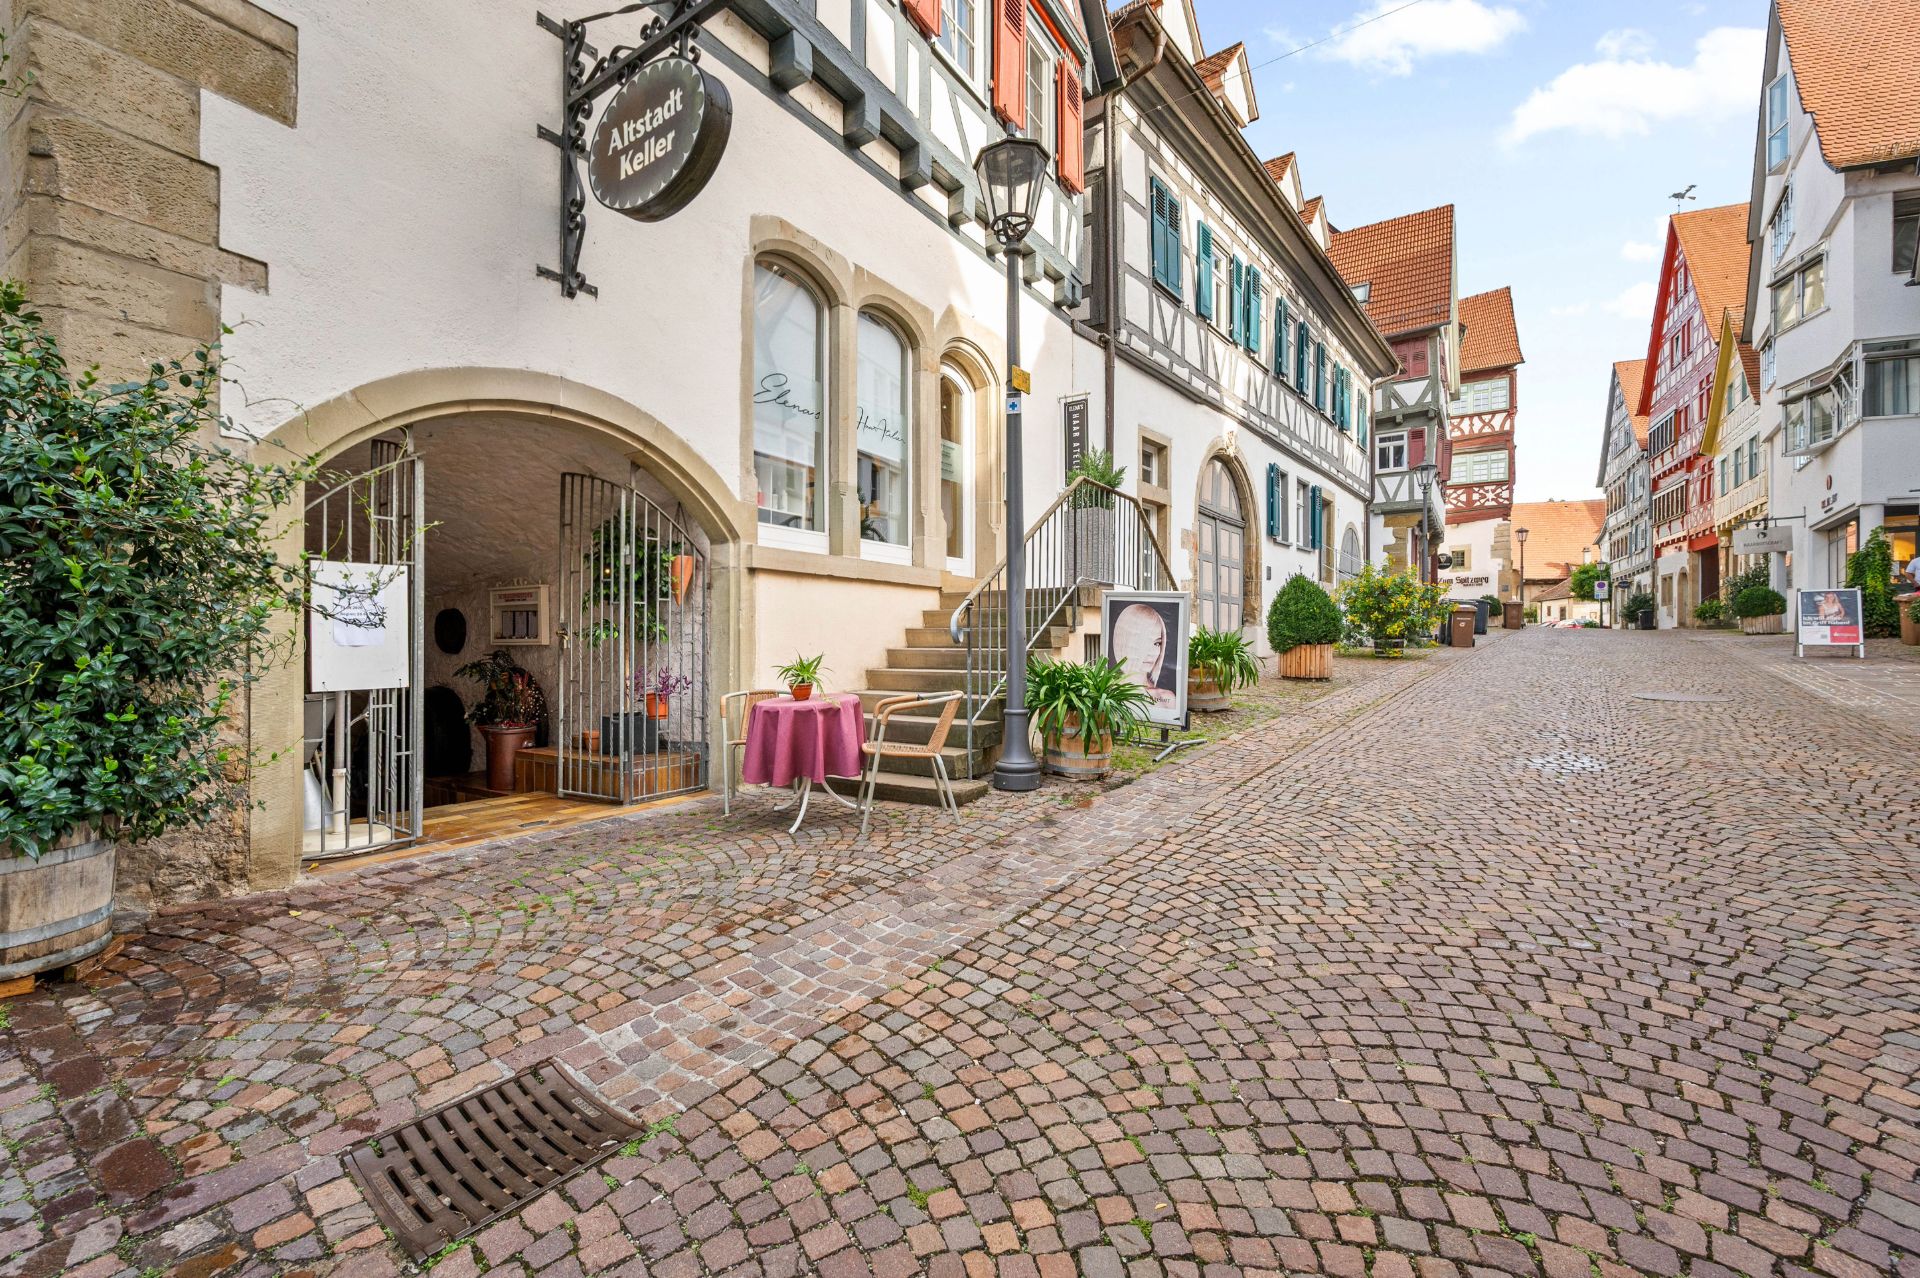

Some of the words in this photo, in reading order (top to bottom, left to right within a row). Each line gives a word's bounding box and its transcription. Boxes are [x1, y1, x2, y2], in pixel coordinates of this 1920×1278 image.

[607, 86, 684, 156] Altstadt
[620, 129, 676, 181] Keller
[1072, 413, 1080, 437] HAAR
[1072, 442, 1081, 470] ATELI
